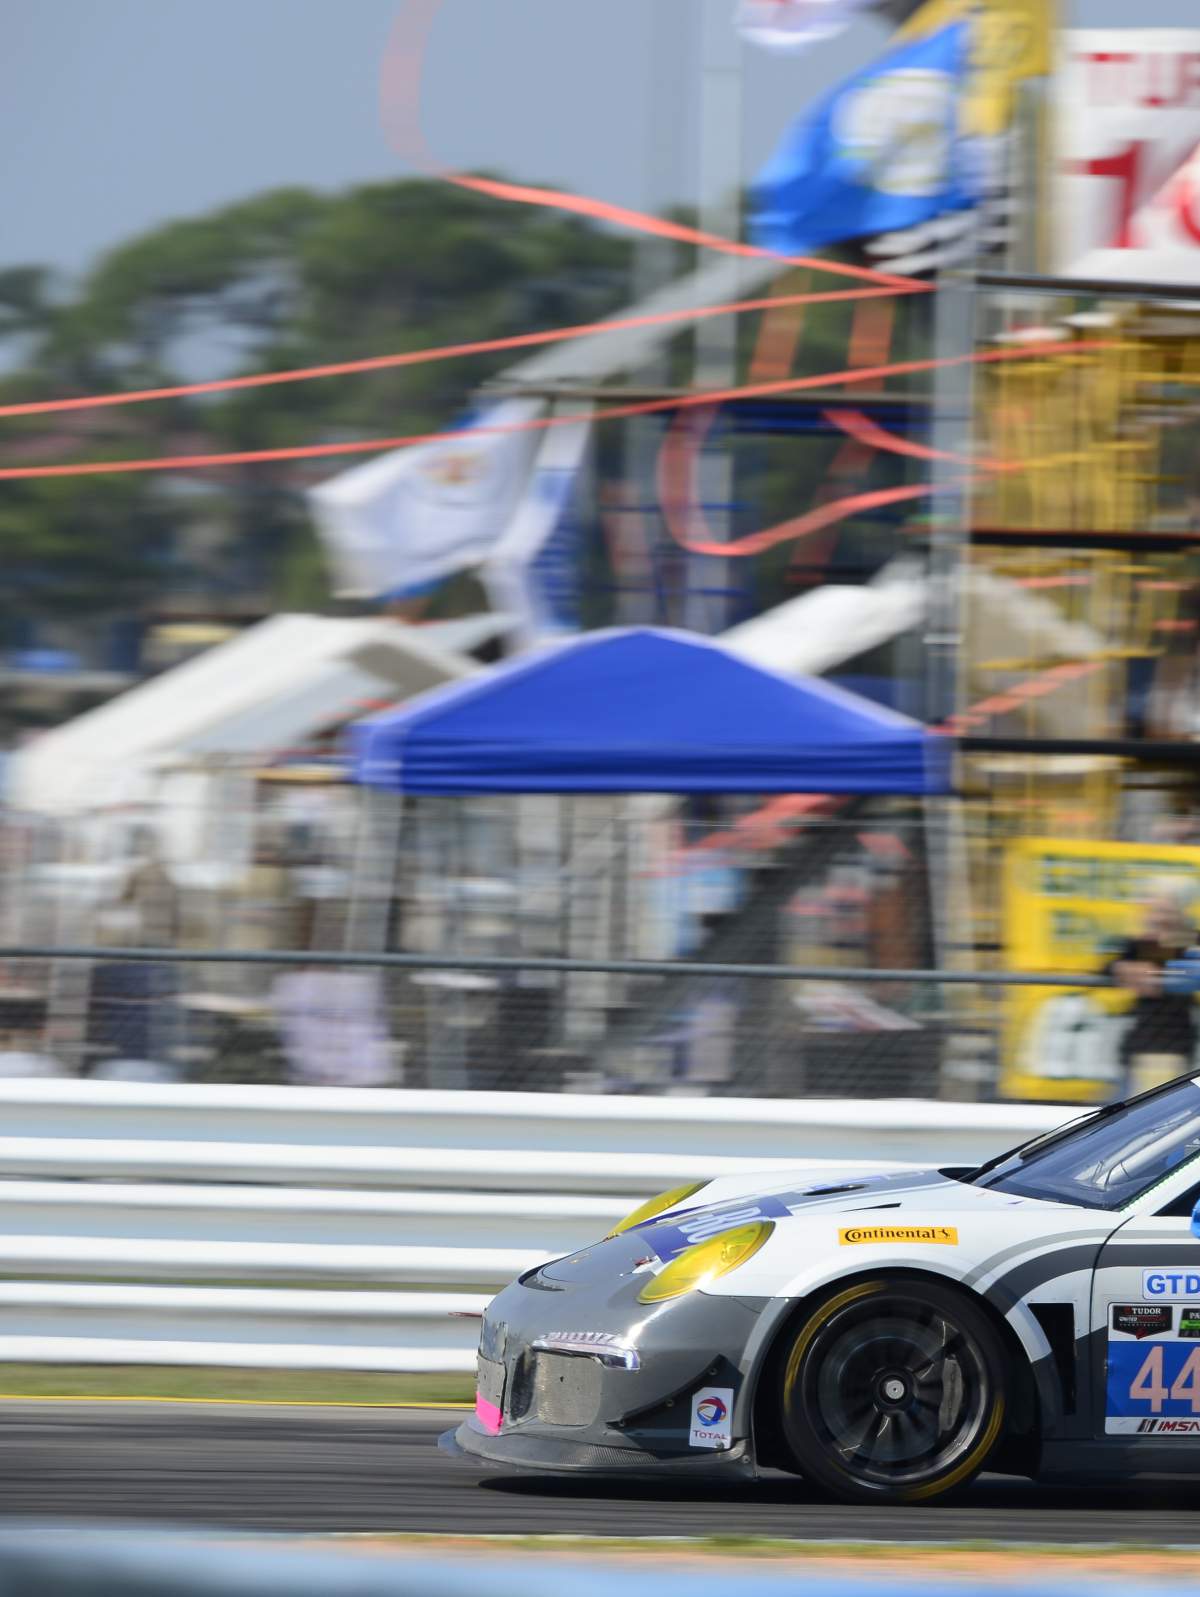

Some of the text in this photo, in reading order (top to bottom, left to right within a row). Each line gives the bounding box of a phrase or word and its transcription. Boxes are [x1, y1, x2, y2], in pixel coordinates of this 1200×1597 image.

[844, 1228, 936, 1243] Continental
[1131, 1307, 1162, 1315] TUDOR
[692, 1429, 729, 1440] TOTAL
